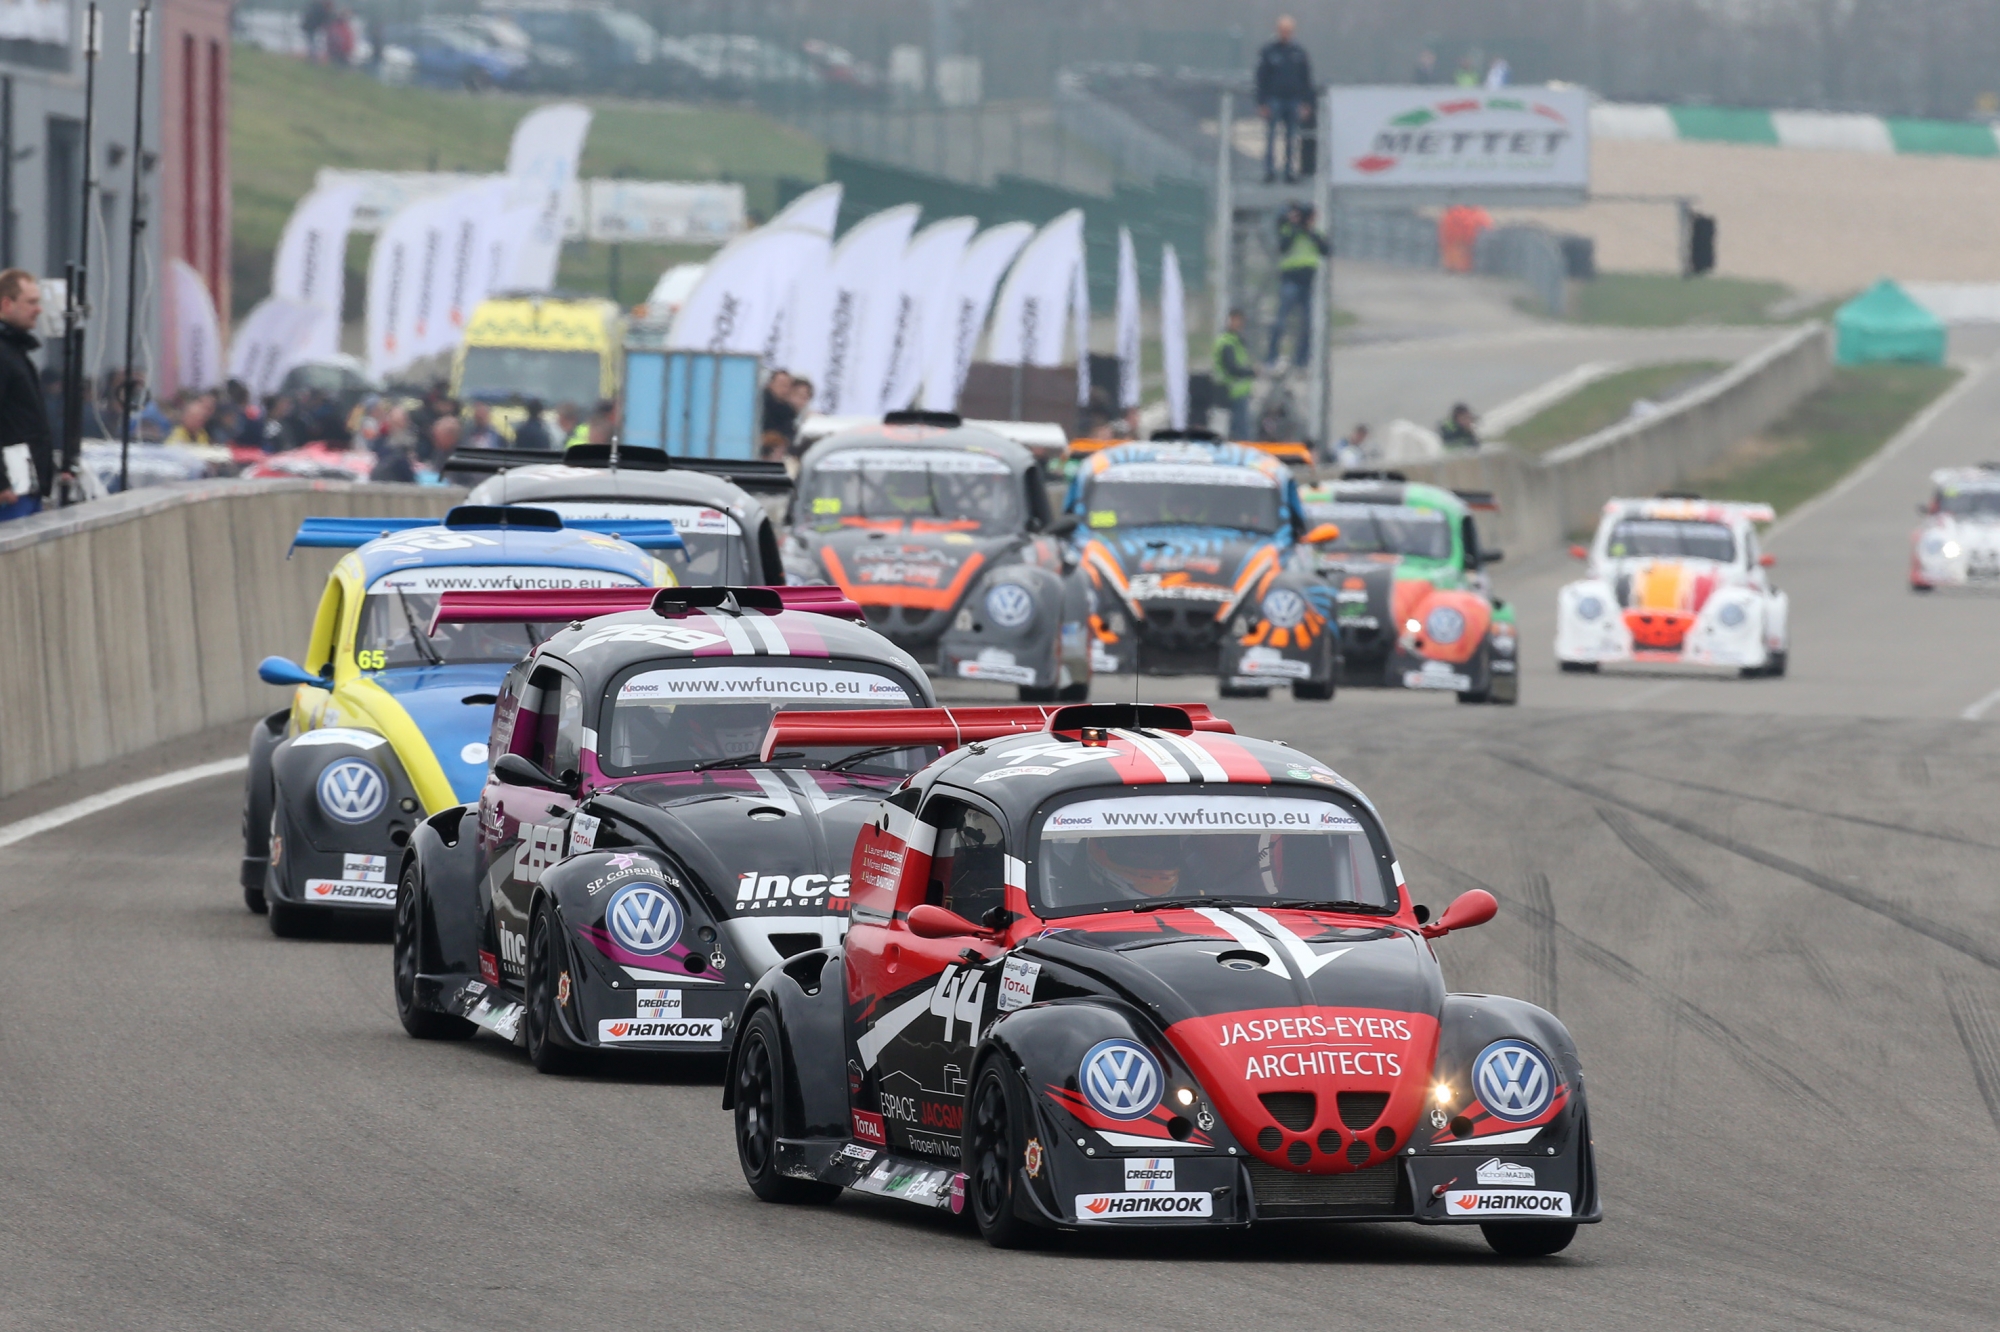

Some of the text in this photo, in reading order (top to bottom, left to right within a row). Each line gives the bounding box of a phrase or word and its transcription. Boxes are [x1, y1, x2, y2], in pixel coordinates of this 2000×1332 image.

[1373, 131, 1570, 154] METTET
[426, 575, 602, 588] www.vwfuncup.eu
[566, 624, 727, 655] 269
[358, 650, 385, 669] 65
[622, 682, 659, 692] KRONOS
[668, 676, 860, 696] www.vwfuncup.eu
[997, 742, 1120, 767] 44
[1052, 813, 1092, 826] KRONOS
[1101, 808, 1310, 827] www.vwfuncup.eu
[1320, 812, 1358, 824] KRONOS
[514, 822, 564, 883] 269
[587, 878, 604, 893] SP
[606, 867, 680, 888] Consulting
[735, 897, 823, 910] GARAGE
[1003, 976, 1031, 995] TOTAL
[638, 998, 680, 1008] CREDECO
[930, 964, 987, 1047] 44
[627, 1022, 714, 1038] HANKOOK
[1219, 1015, 1412, 1047] JASPERS-EYERS
[1245, 1051, 1402, 1080] ARCHITECTS
[880, 1092, 918, 1122] ESPACE
[854, 1114, 881, 1137] TOTAL
[908, 1135, 941, 1155] Property
[1126, 1169, 1173, 1180] CREDECO
[1107, 1196, 1204, 1214] HANKOOK
[1477, 1195, 1564, 1211] HANKOOK
